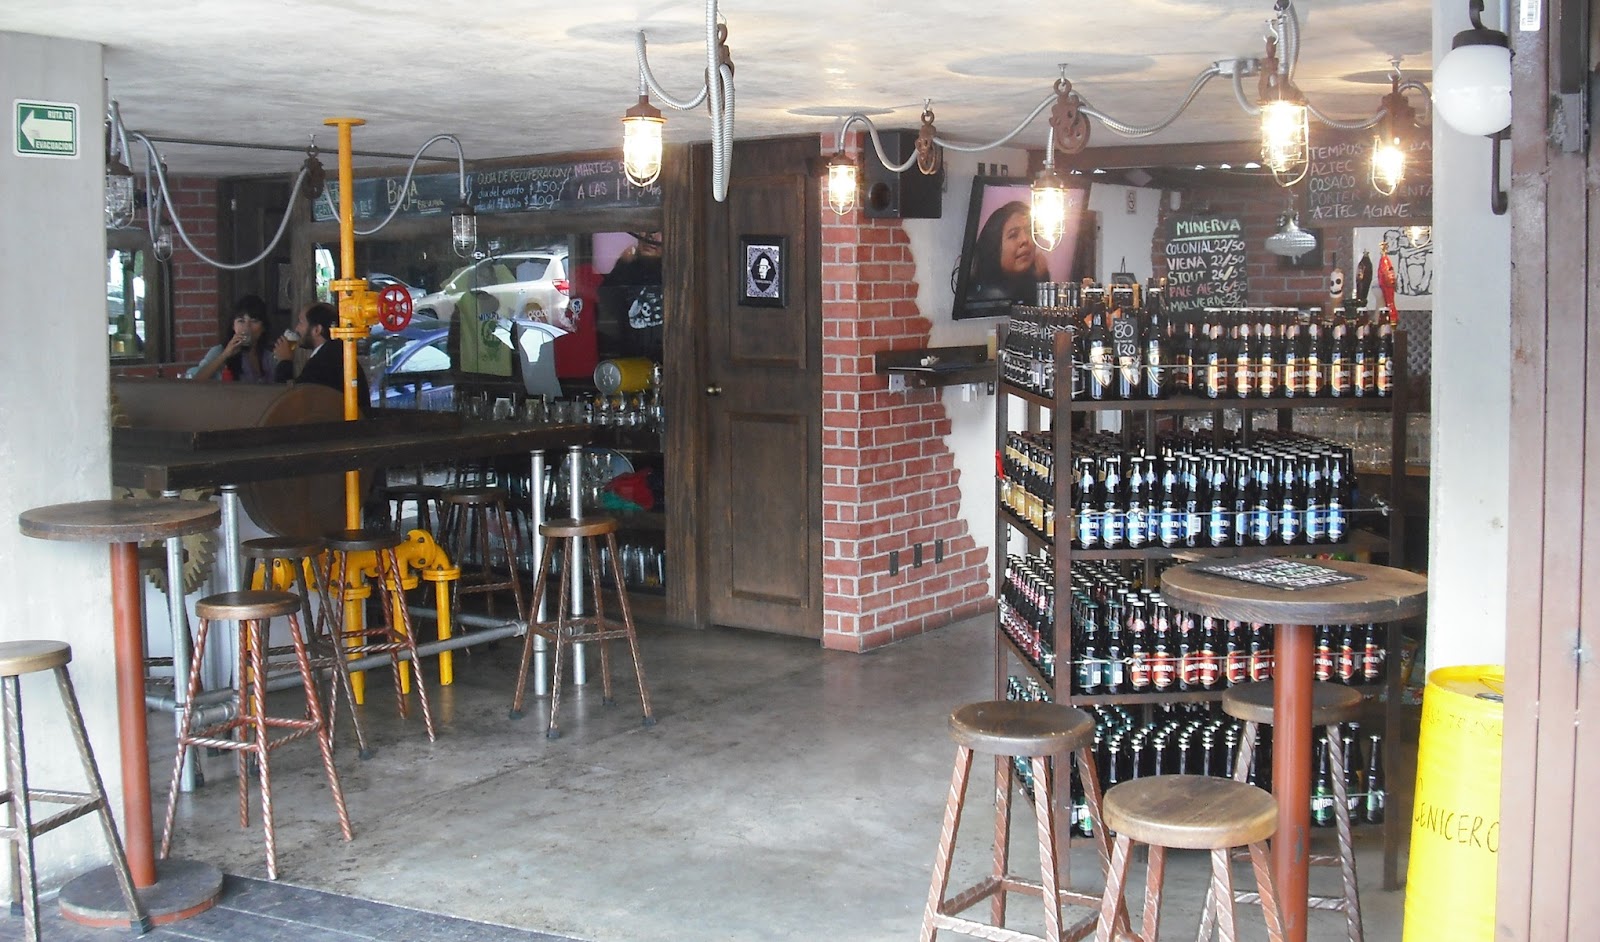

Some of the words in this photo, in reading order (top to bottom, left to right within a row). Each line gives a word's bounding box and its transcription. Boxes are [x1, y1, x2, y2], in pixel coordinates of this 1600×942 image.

[47, 110, 63, 119] RUTA
[64, 112, 73, 120] DE
[1309, 143, 1362, 159] TEMPUS
[574, 162, 613, 177] MARTES
[1310, 160, 1353, 176] AZTEC
[577, 184, 585, 199] A
[589, 182, 607, 197] LAS
[1310, 174, 1356, 192] COSACO
[1176, 218, 1241, 236] MINERVA
[1166, 240, 1214, 255] COLONIAL
[1214, 239, 1245, 253] 22/50
[1167, 255, 1207, 270] VIENA
[1211, 253, 1245, 267] 22/50
[1168, 270, 1206, 286] STOUT
[1169, 285, 1193, 297] PALE
[1197, 283, 1214, 295] ALE
[1170, 295, 1226, 312] MALVERDE
[1114, 324, 1134, 338] 80
[1117, 343, 1136, 356] 120
